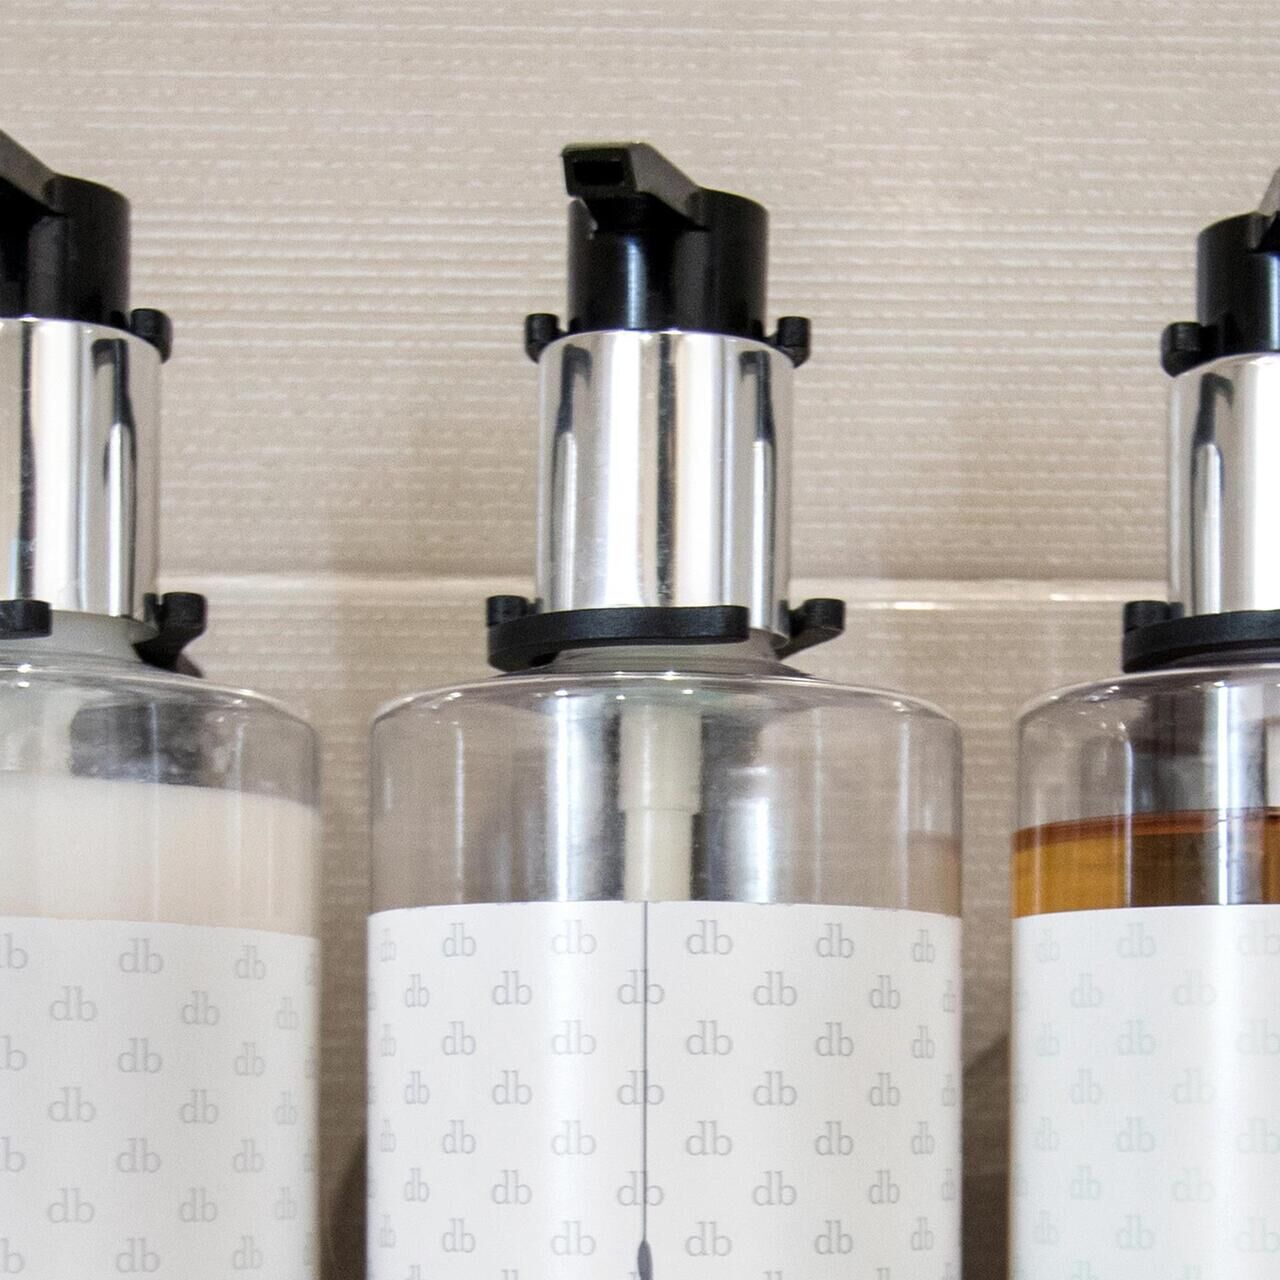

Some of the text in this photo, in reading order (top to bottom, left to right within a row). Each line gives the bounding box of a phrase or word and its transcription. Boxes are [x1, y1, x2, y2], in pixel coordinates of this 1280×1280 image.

[442, 923, 476, 957] db
[684, 920, 733, 955] db
[815, 924, 855, 959] db
[118, 939, 163, 973] db
[235, 947, 265, 979] db
[49, 986, 97, 1021] db
[491, 970, 532, 1005] db
[752, 971, 798, 1006] db
[868, 975, 901, 1009] db
[179, 990, 220, 1025] db
[117, 1038, 162, 1073] db
[441, 1021, 476, 1055] db
[684, 1020, 733, 1056] db
[814, 1022, 854, 1057] db
[47, 1087, 96, 1122] db
[491, 1070, 532, 1105] db
[752, 1071, 798, 1106] db
[867, 1071, 900, 1107] db
[178, 1088, 219, 1124] db
[441, 1120, 476, 1154] db
[684, 1120, 733, 1156] db
[814, 1121, 854, 1156] db
[115, 1138, 162, 1173] db
[490, 1169, 532, 1205] db
[752, 1171, 797, 1206] db
[867, 1169, 900, 1205] db
[46, 1188, 94, 1223] db
[178, 1187, 218, 1223] db
[441, 1218, 476, 1253] db
[551, 1222, 596, 1255] db
[684, 1221, 732, 1257] db
[813, 1220, 854, 1255] db
[115, 1238, 160, 1273] db
